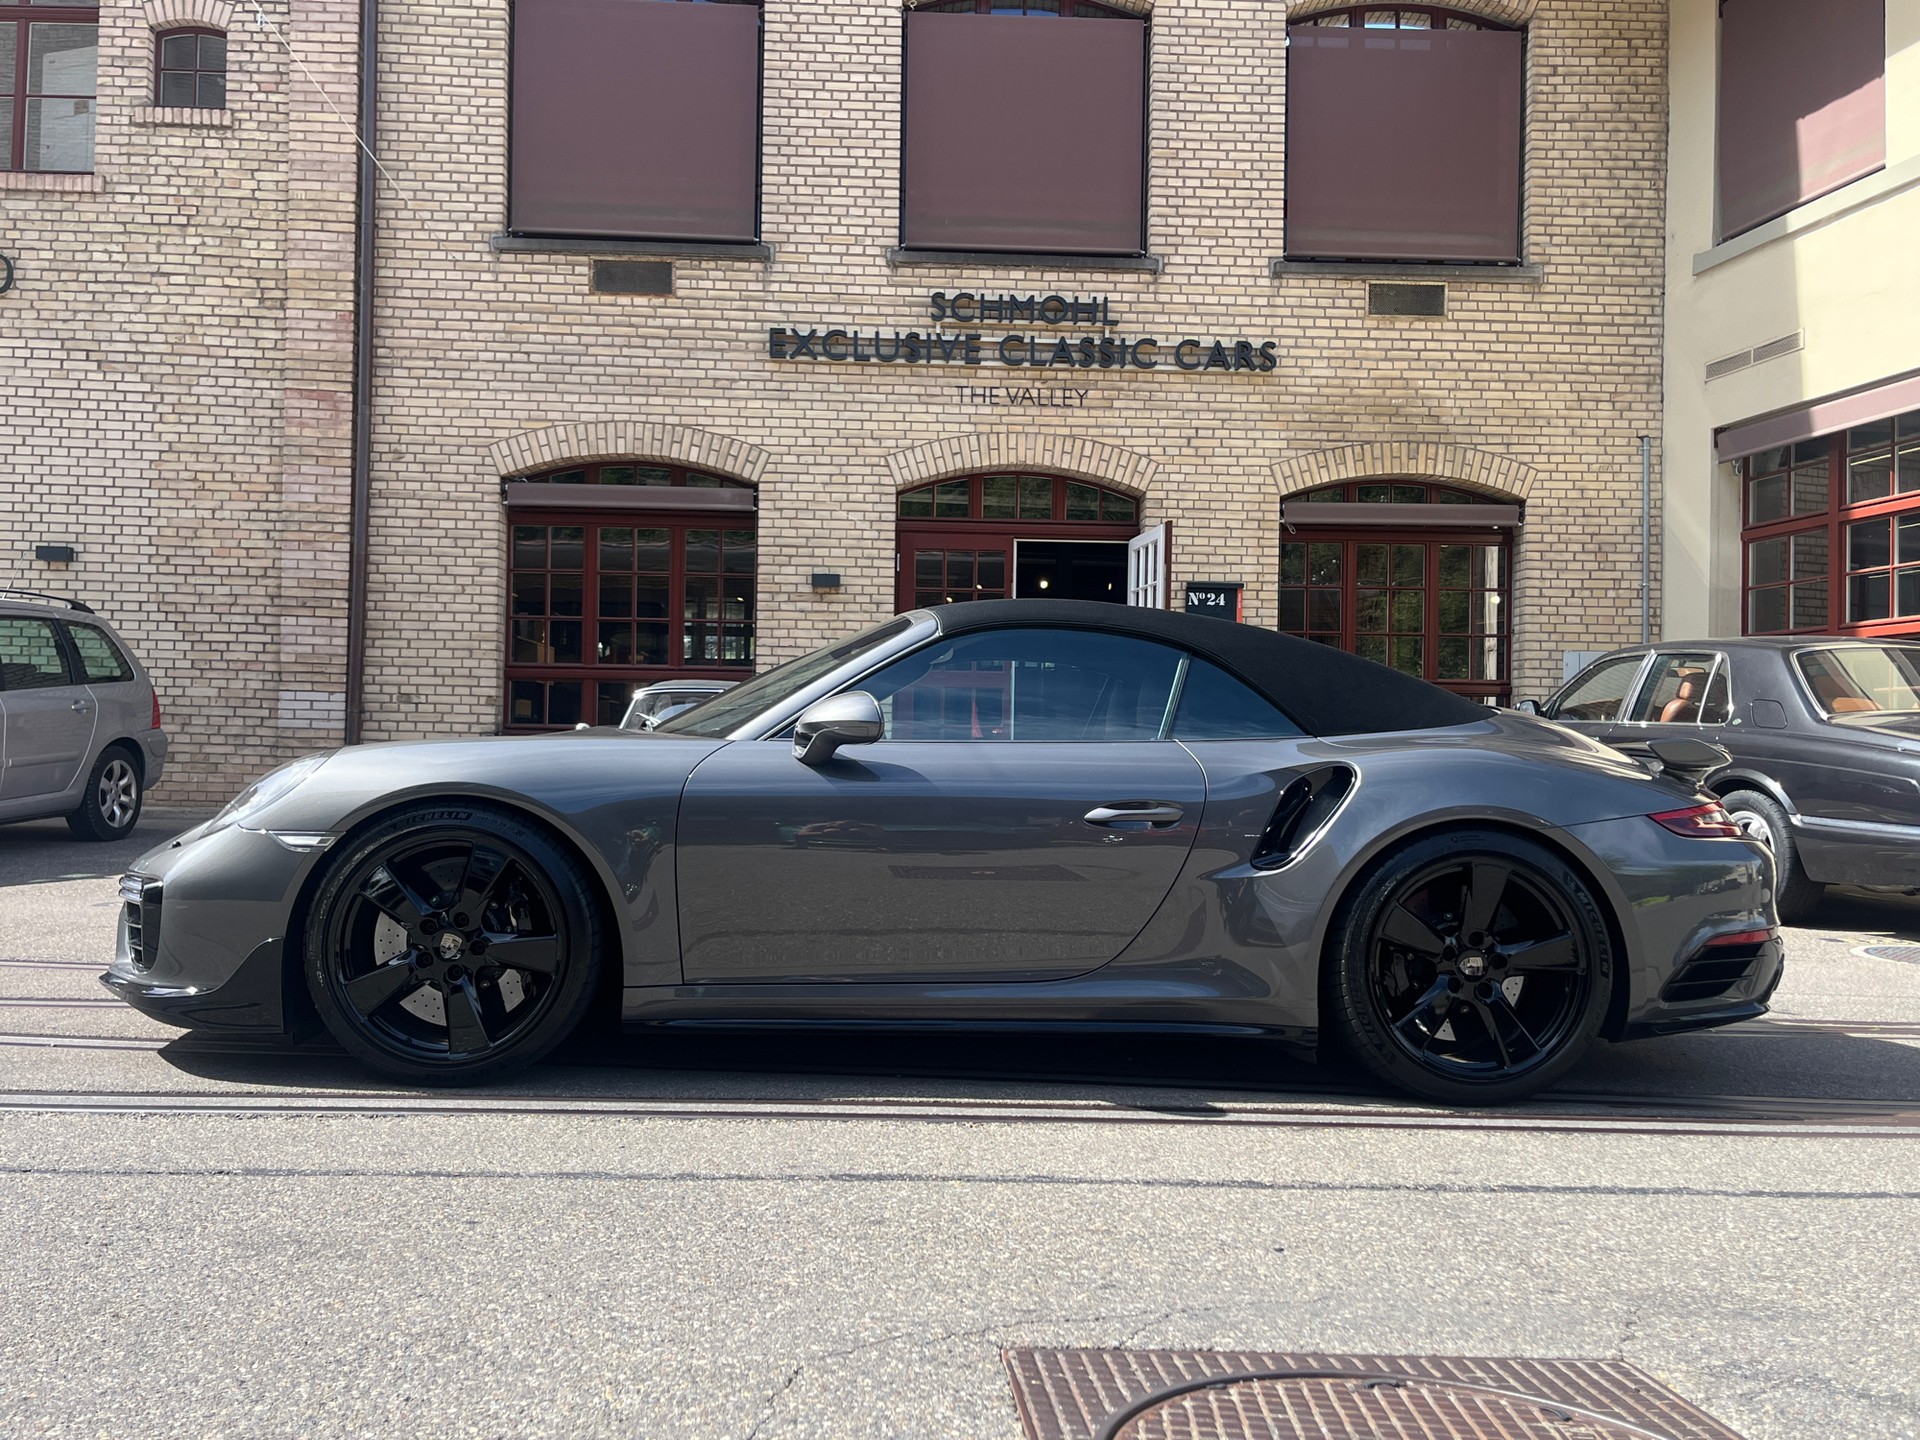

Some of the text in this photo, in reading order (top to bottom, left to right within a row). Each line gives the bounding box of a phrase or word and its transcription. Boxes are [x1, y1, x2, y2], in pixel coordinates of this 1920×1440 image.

[931, 292, 1120, 326] SCHMOHL
[769, 327, 1277, 372] EXCLUSIVE CLASSIC CARS
[955, 386, 1089, 407] THE VALLEY
